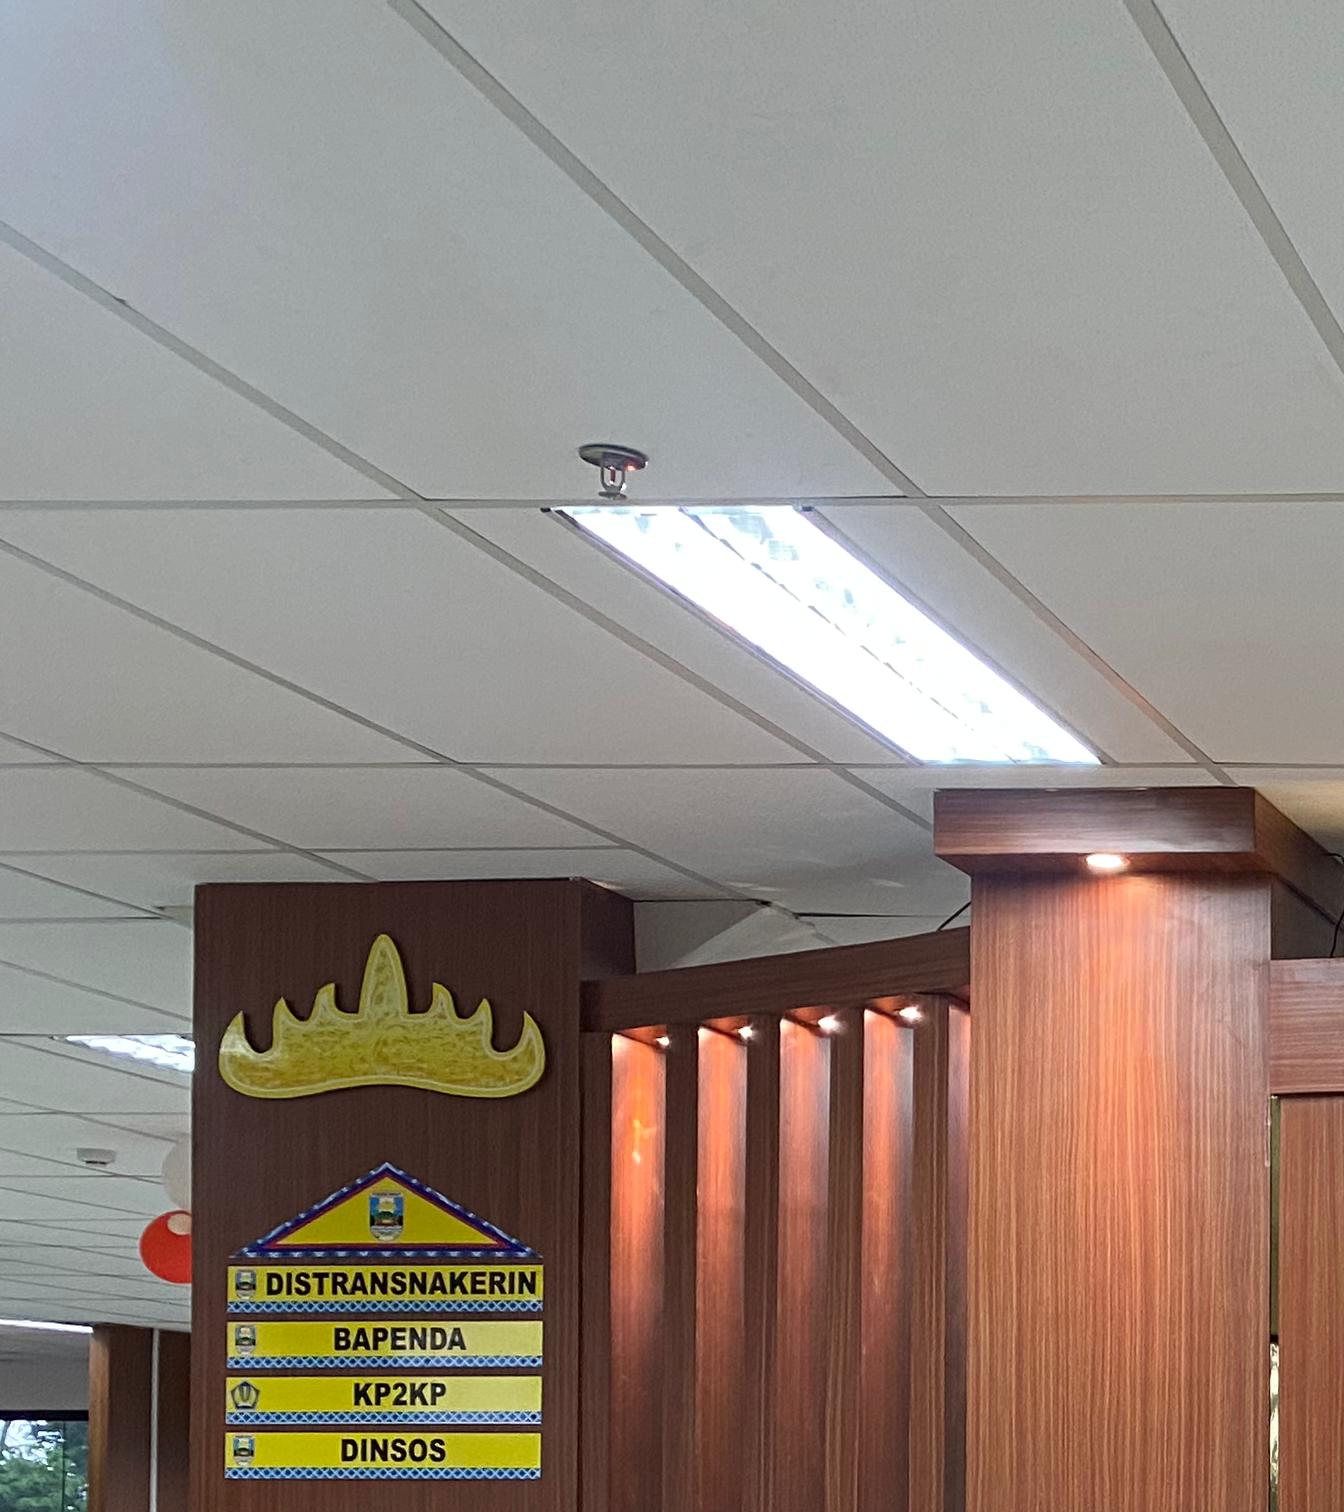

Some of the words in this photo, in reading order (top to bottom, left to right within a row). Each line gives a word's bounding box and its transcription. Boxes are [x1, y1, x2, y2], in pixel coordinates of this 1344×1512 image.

[267, 1272, 536, 1295] DISTRANSNAKERIN
[335, 1328, 466, 1350] BAPENDA
[354, 1383, 446, 1406] KP2KP
[342, 1439, 445, 1462] DINSOS
